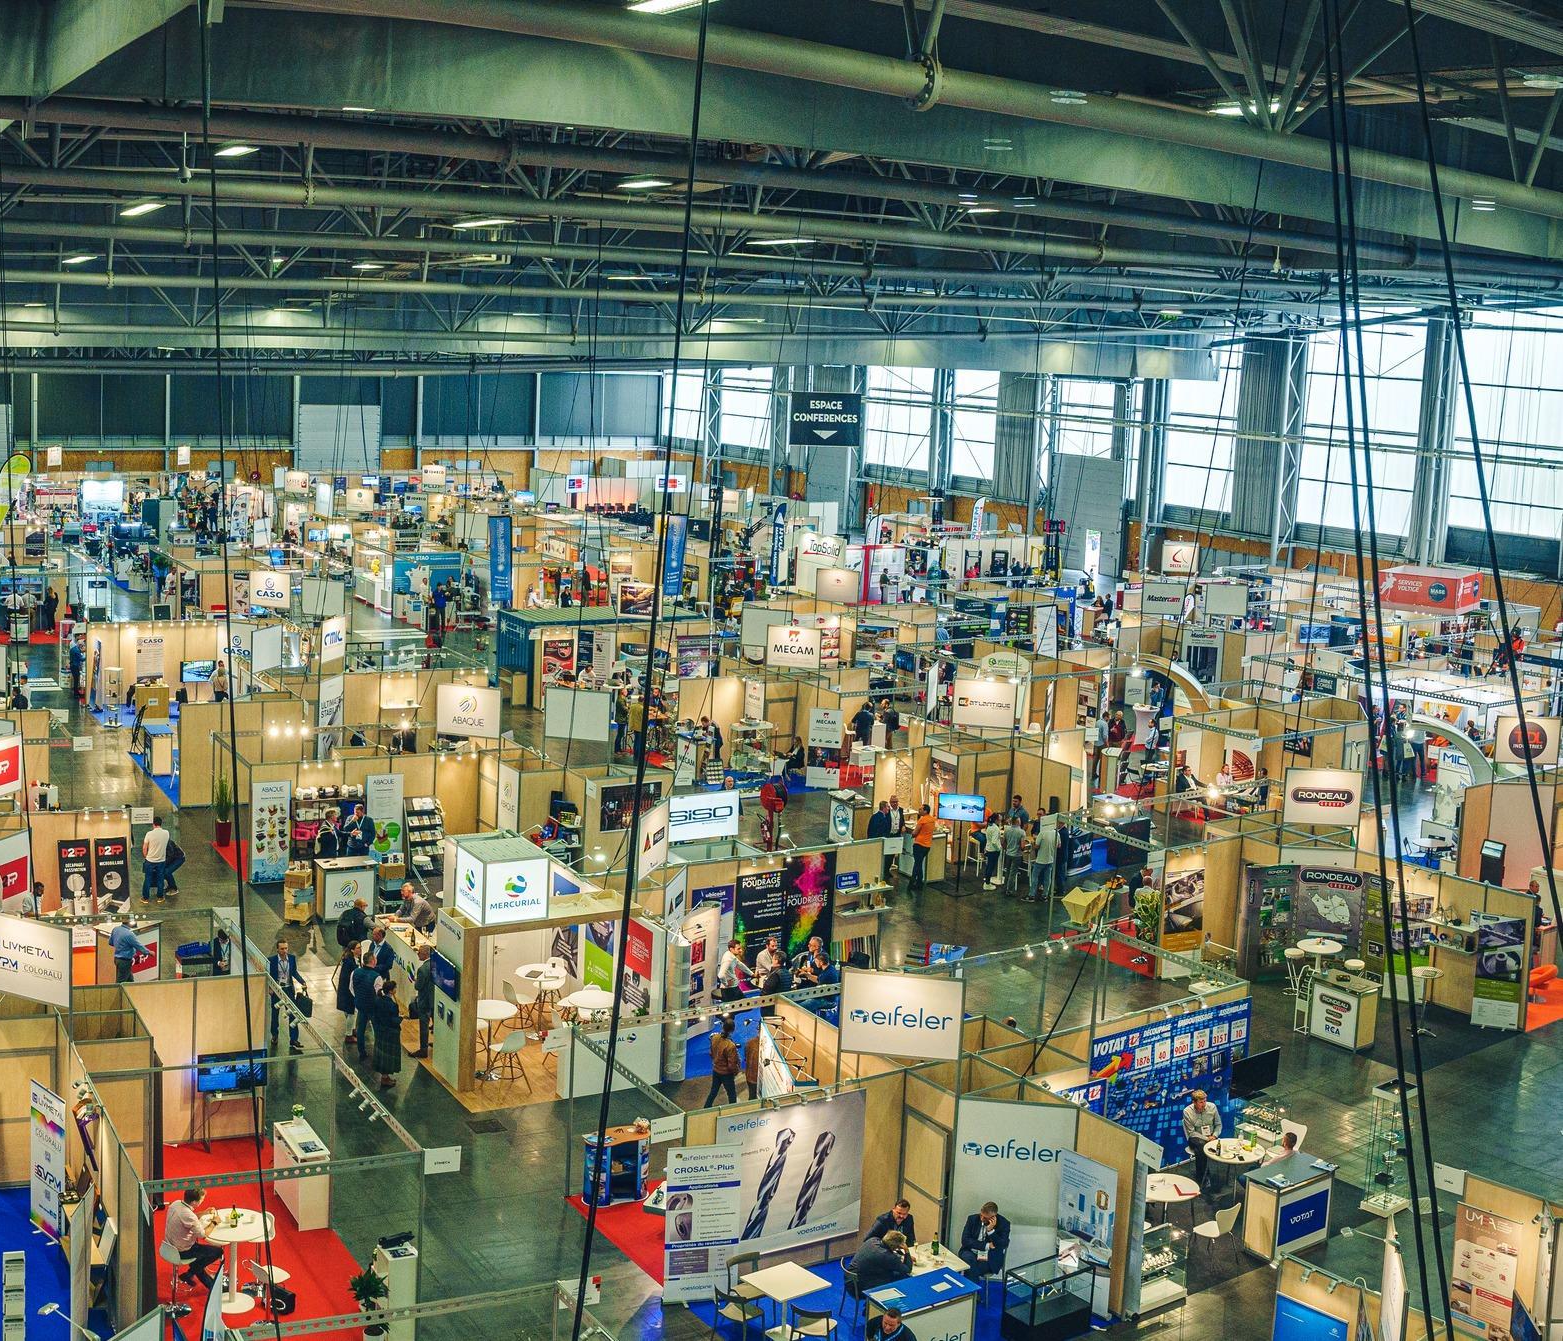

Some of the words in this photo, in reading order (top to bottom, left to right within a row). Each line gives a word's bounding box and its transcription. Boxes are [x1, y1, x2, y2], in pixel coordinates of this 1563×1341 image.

[809, 400, 843, 410] ESPACE
[793, 413, 858, 423] CONFERENCES
[810, 539, 841, 557] TopSolid
[1397, 579, 1423, 587] SERVICES
[1397, 585, 1419, 593] VOLTIGE
[256, 590, 284, 599] CASO
[1147, 594, 1181, 603] Mastercam
[773, 644, 814, 656] MECAM
[452, 716, 485, 727] ABAQUE
[261, 785, 285, 793] ABAQUE
[1298, 791, 1348, 800] RONDEAU
[1, 872, 19, 888] 2FP
[742, 877, 781, 889] POUDRAGE
[1307, 871, 1357, 884] RONDEAU
[333, 900, 355, 909] ABAQ
[489, 898, 541, 910] MERCURIAL
[786, 894, 828, 907] POUDRAGE
[2, 939, 55, 960] LIVMETAL
[23, 963, 63, 981] COLORALU
[871, 1006, 953, 1031] eifeler
[1235, 1030, 1243, 1038] 10
[1325, 1023, 1341, 1036] RCA
[1093, 1036, 1127, 1058] VOTAT
[1174, 1044, 1189, 1055] 9001
[1197, 1039, 1205, 1048] 30
[1158, 1051, 1167, 1060] 40
[1136, 1056, 1151, 1068] 1876
[38, 1098, 64, 1122] LIVMETAL
[736, 1117, 772, 1131] eifeler
[35, 1127, 62, 1153] COLORALU
[983, 1139, 1063, 1163] eifeler
[682, 1153, 711, 1162] eifeler
[36, 1164, 62, 1193] SVPM
[688, 1183, 719, 1191] Applications
[1290, 1209, 1315, 1225] VOTAT
[796, 1221, 837, 1236] voestalpine
[679, 1282, 713, 1293] voestalpine
